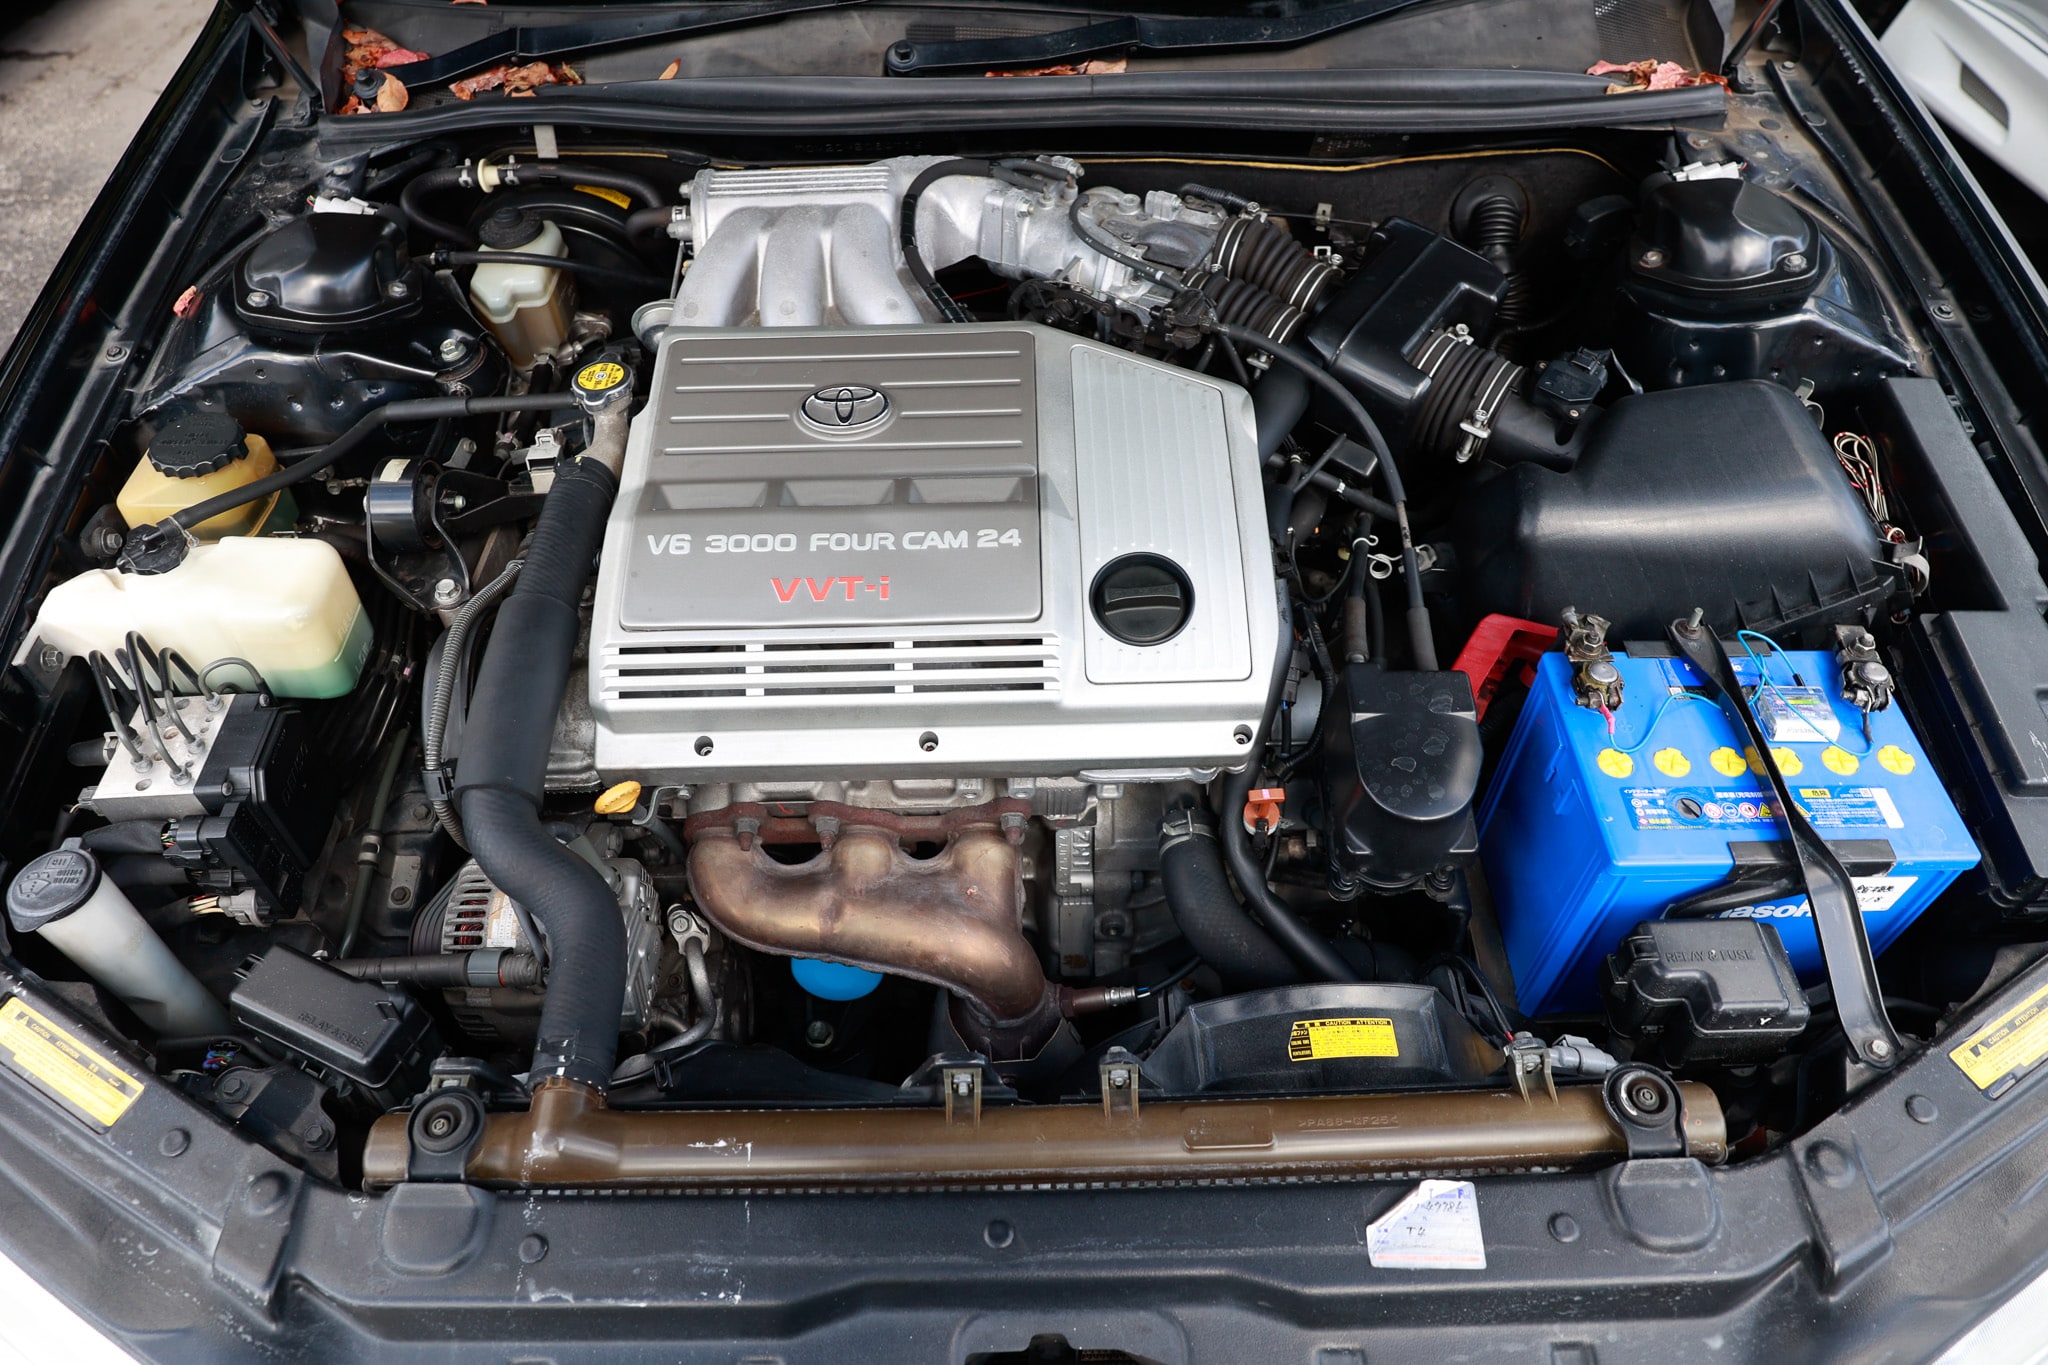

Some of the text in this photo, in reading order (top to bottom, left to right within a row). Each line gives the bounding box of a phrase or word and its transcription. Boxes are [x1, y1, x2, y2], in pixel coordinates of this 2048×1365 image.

[647, 528, 1022, 555] V6 3000 FOUR CAM 24
[771, 575, 891, 603] VVT-i
[1664, 950, 1704, 963] RELAY
[1719, 949, 1756, 961] FUSE
[1987, 1028, 2010, 1045] CAUTION
